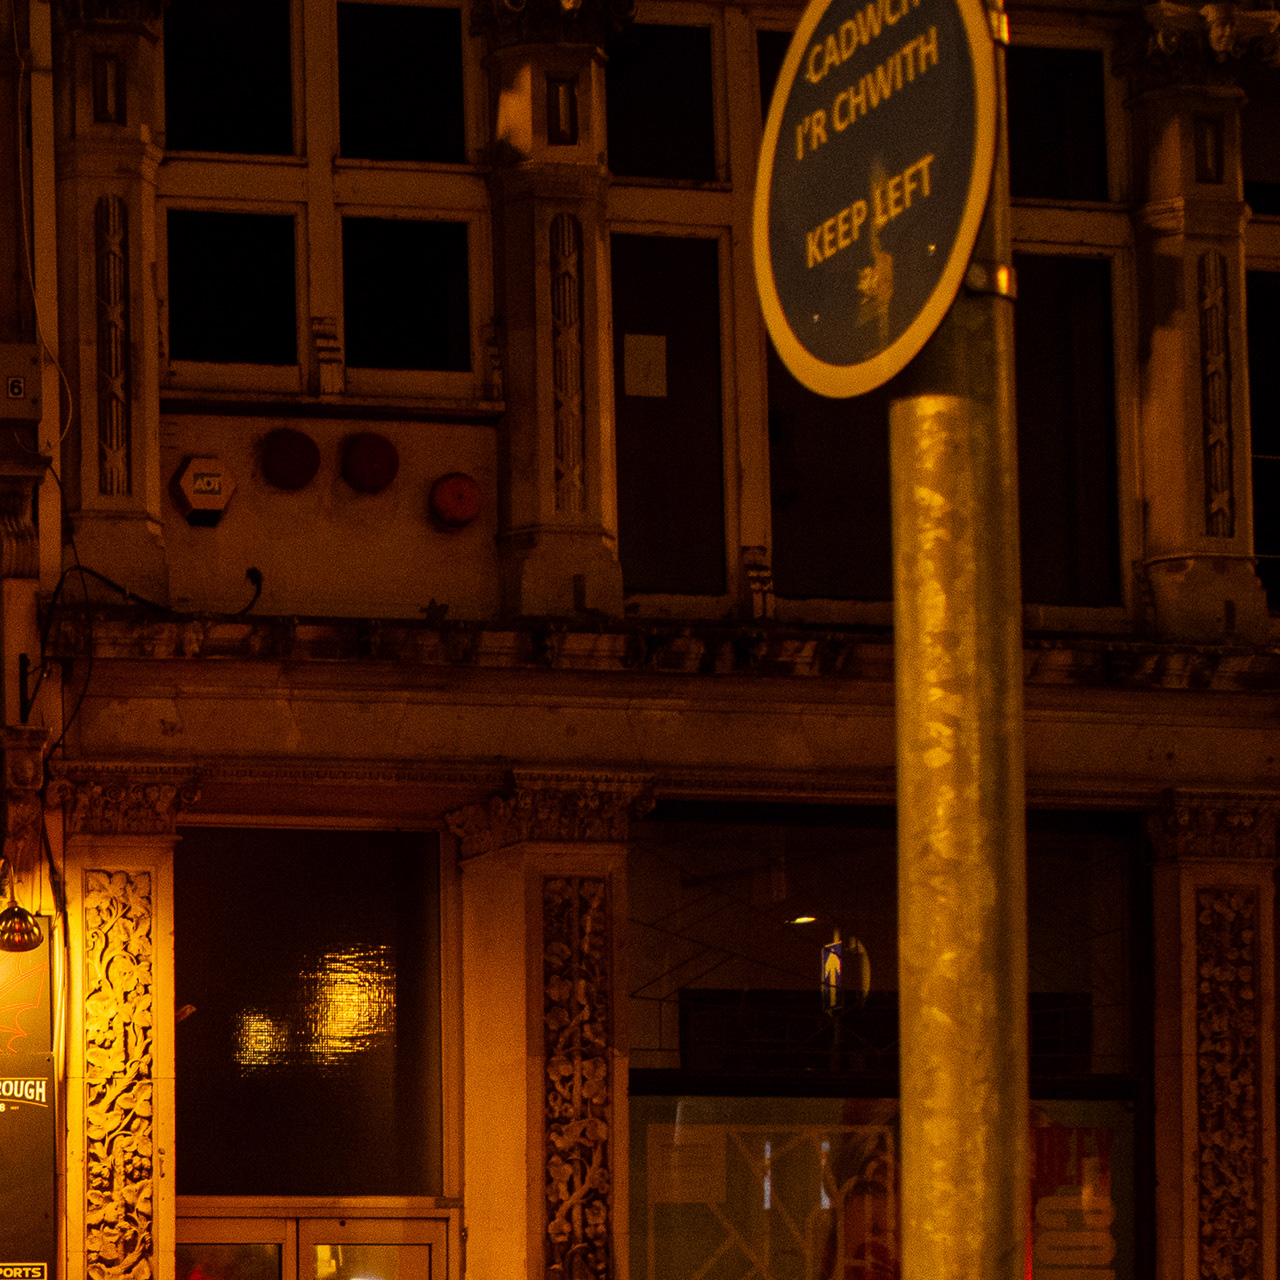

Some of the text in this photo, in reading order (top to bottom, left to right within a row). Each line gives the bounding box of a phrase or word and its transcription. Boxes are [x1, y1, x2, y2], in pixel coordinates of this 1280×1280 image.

[805, 0, 920, 83] CADWC
[832, 26, 938, 132] CHWITH
[805, 154, 934, 268] KEEP LEFT
[10, 380, 22, 395] 6
[194, 477, 220, 491] ADT
